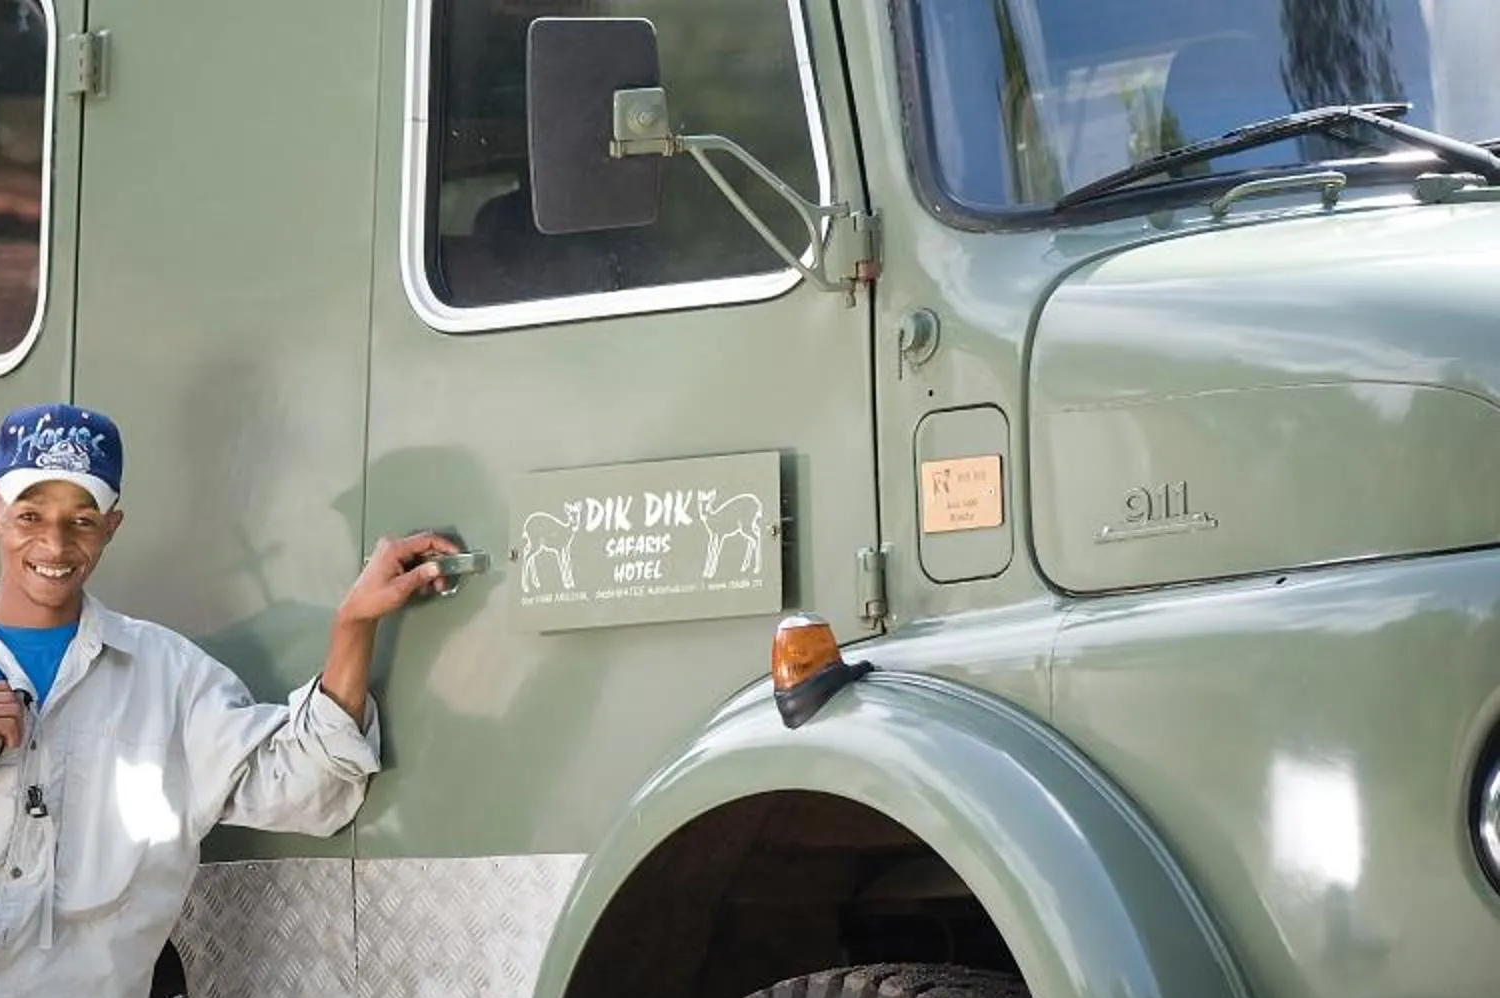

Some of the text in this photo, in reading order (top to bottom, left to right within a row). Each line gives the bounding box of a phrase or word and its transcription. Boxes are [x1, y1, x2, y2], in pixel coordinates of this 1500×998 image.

[585, 489, 693, 532] DIK DIK
[1124, 480, 1188, 523] 911
[605, 533, 671, 558] SAFARIS
[613, 560, 662, 583] HOTEL
